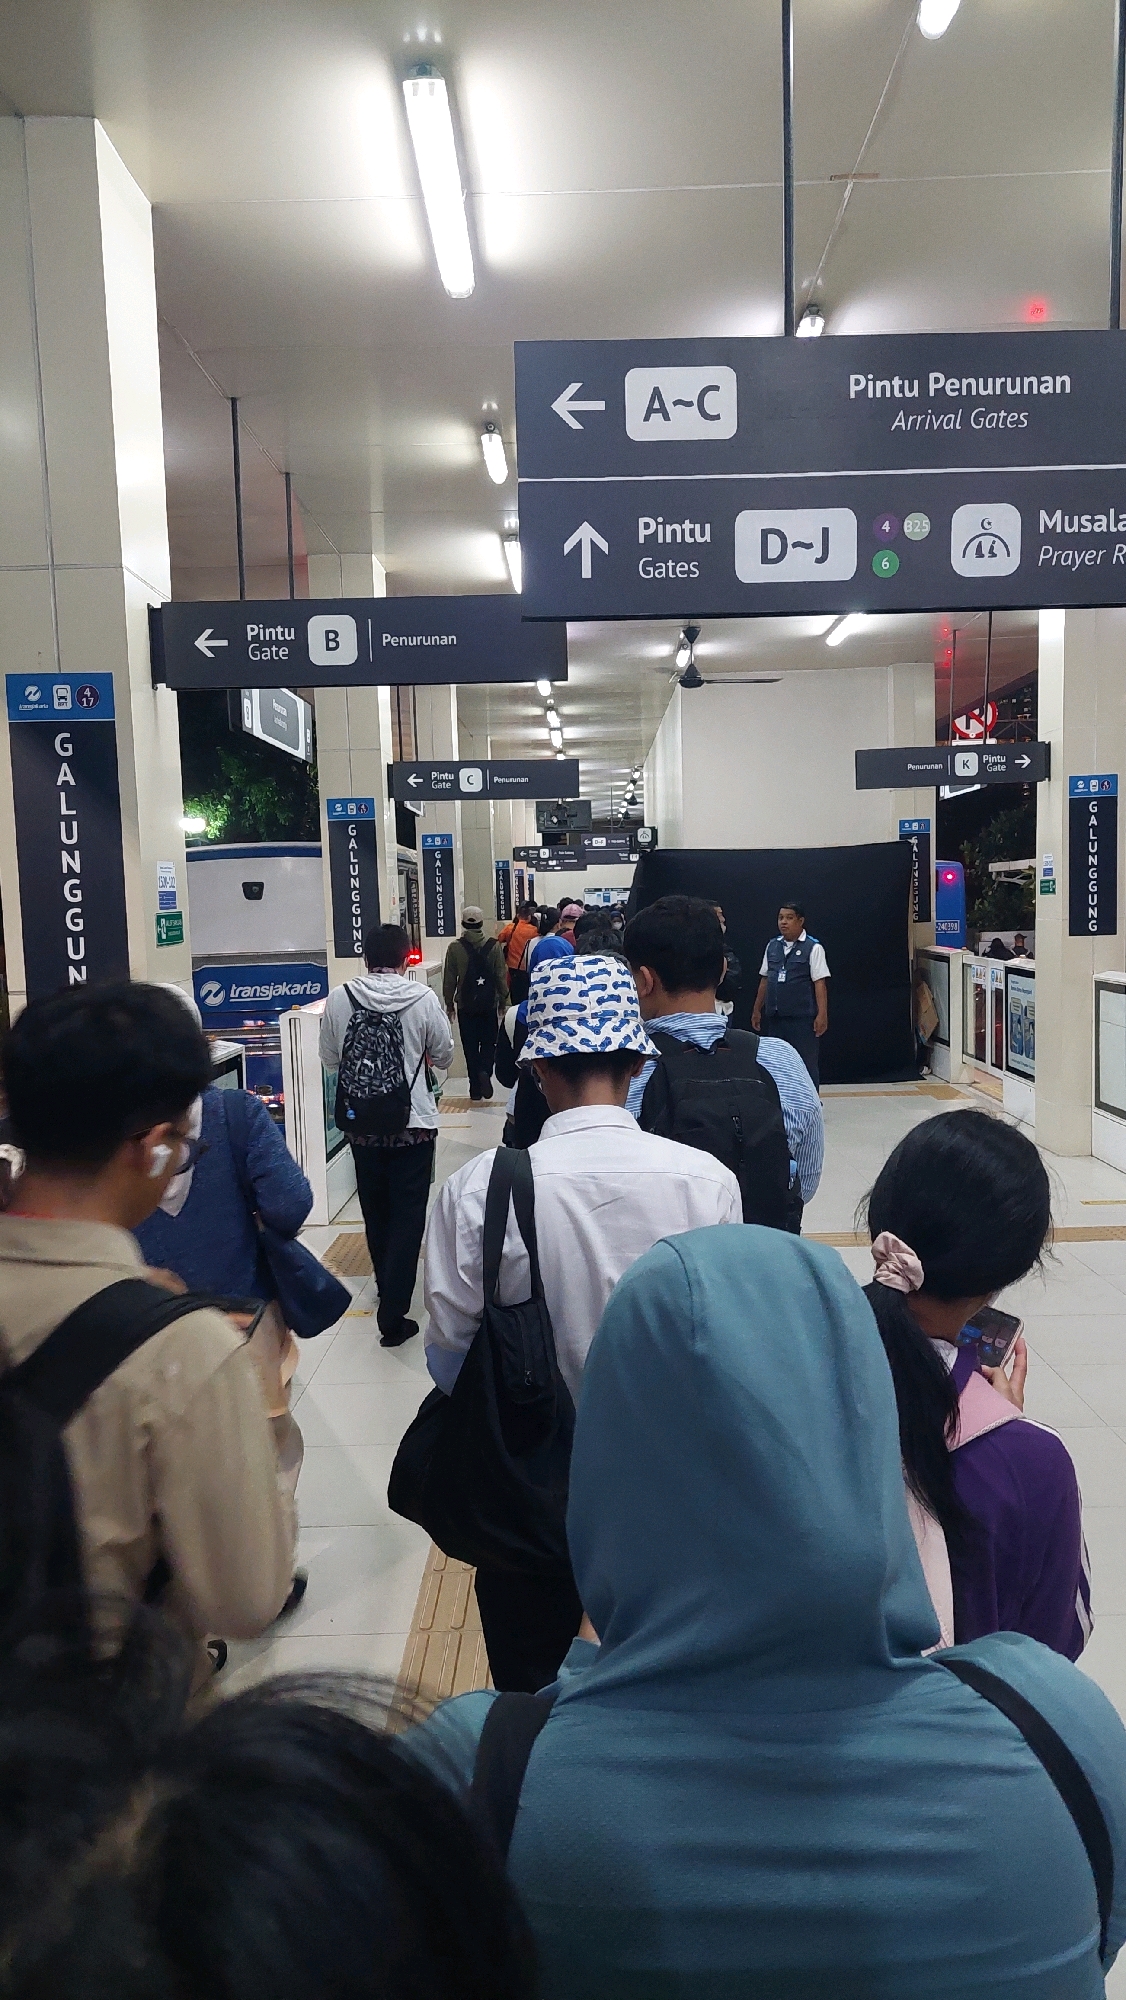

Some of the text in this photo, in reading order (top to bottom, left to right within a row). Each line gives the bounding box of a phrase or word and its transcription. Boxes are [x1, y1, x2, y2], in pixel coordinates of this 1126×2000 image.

[849, 372, 1071, 399] Pintu Penurunan
[643, 385, 721, 422] A~C
[891, 407, 1029, 431] Arrival Gates
[638, 517, 711, 544] Pintu
[881, 520, 929, 533] 4 B25
[761, 527, 830, 565] D~J
[881, 556, 890, 570] 6
[1037, 545, 1107, 572] Prayer
[638, 557, 700, 579] Gates
[246, 624, 296, 642] Pintu
[325, 629, 340, 652] B
[382, 633, 457, 647] Penurunan
[248, 643, 289, 661] Gate
[83, 687, 92, 697] 4
[81, 697, 95, 708] 17
[907, 763, 943, 771] Penurunan
[962, 759, 971, 770] K
[982, 754, 1007, 764] Pintu
[986, 763, 1007, 772] Gate
[431, 771, 455, 780] Pintu
[467, 774, 474, 786] C
[493, 776, 529, 784] Penurunan
[431, 781, 452, 790] Gate
[1088, 800, 1099, 933] GALUNGGUNG
[348, 824, 363, 955] GALUNGGUNG
[435, 850, 446, 936] GALUNGGUNG
[229, 980, 321, 1002] transjakarta
